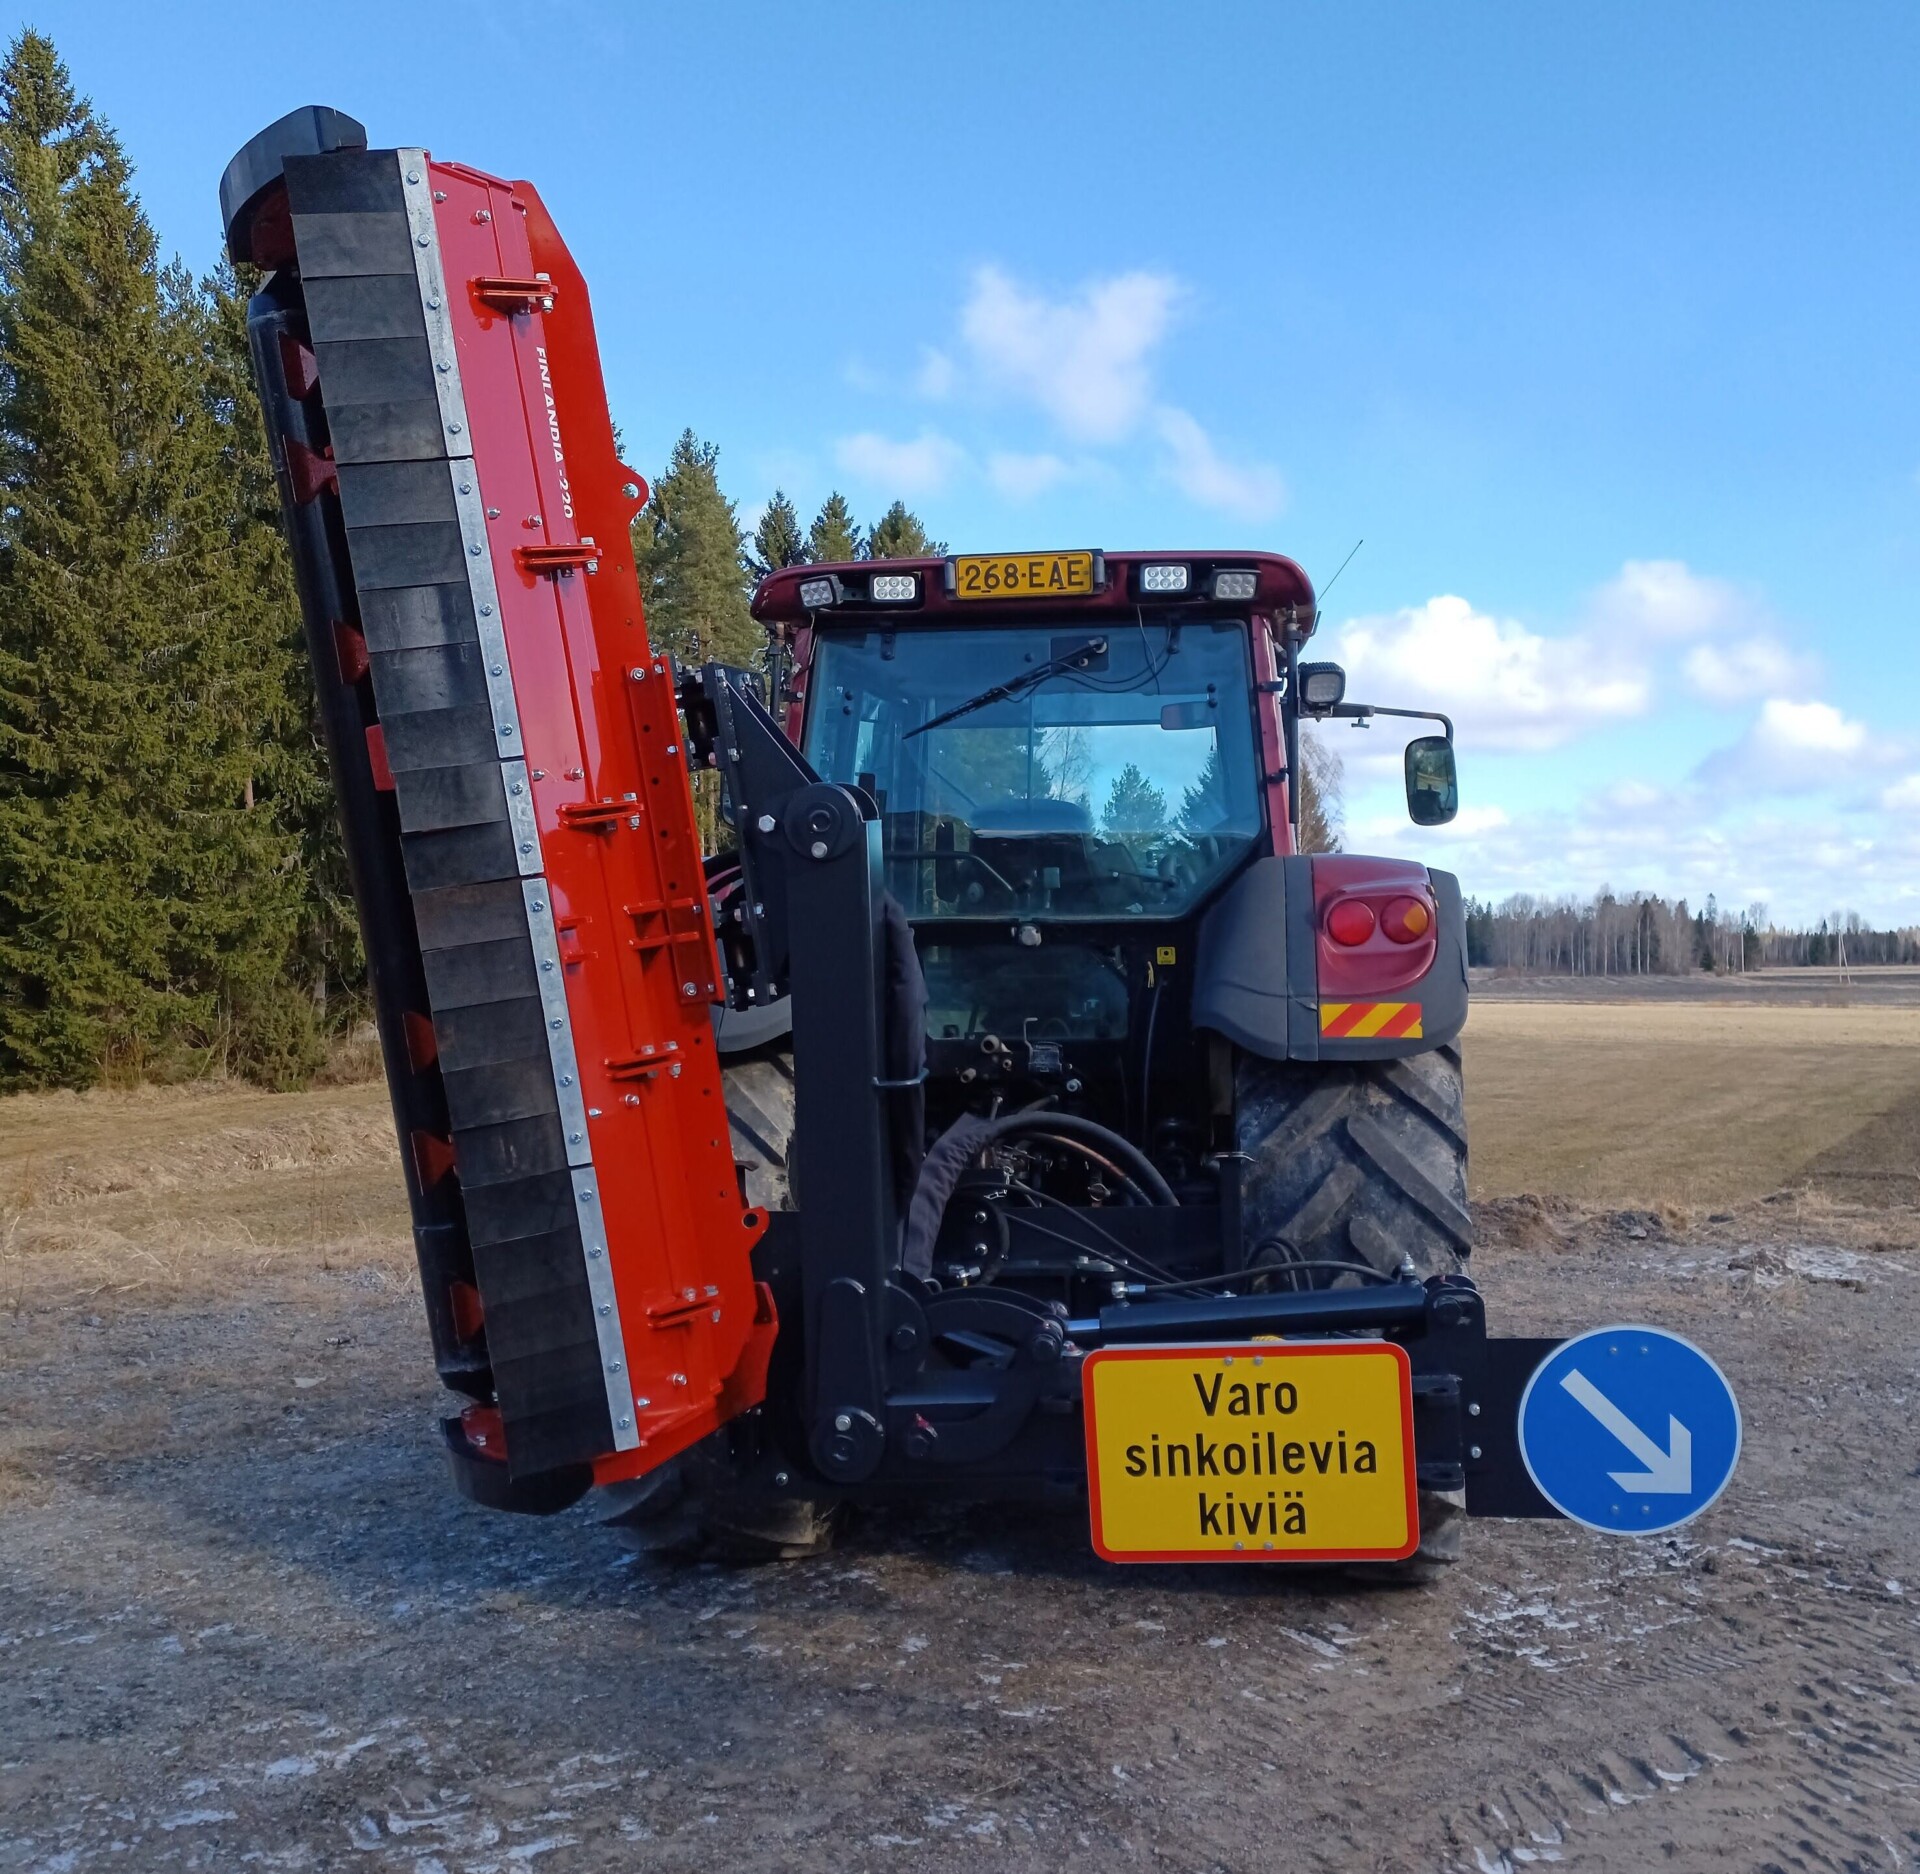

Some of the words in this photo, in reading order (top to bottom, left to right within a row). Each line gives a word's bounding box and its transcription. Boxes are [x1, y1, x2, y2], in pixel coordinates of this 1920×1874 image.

[536, 346, 564, 463] FINLANDIA
[1193, 1372, 1298, 1417] Varo
[1124, 1430, 1377, 1478] sinkoilevia
[1198, 1490, 1307, 1536] kiviä
